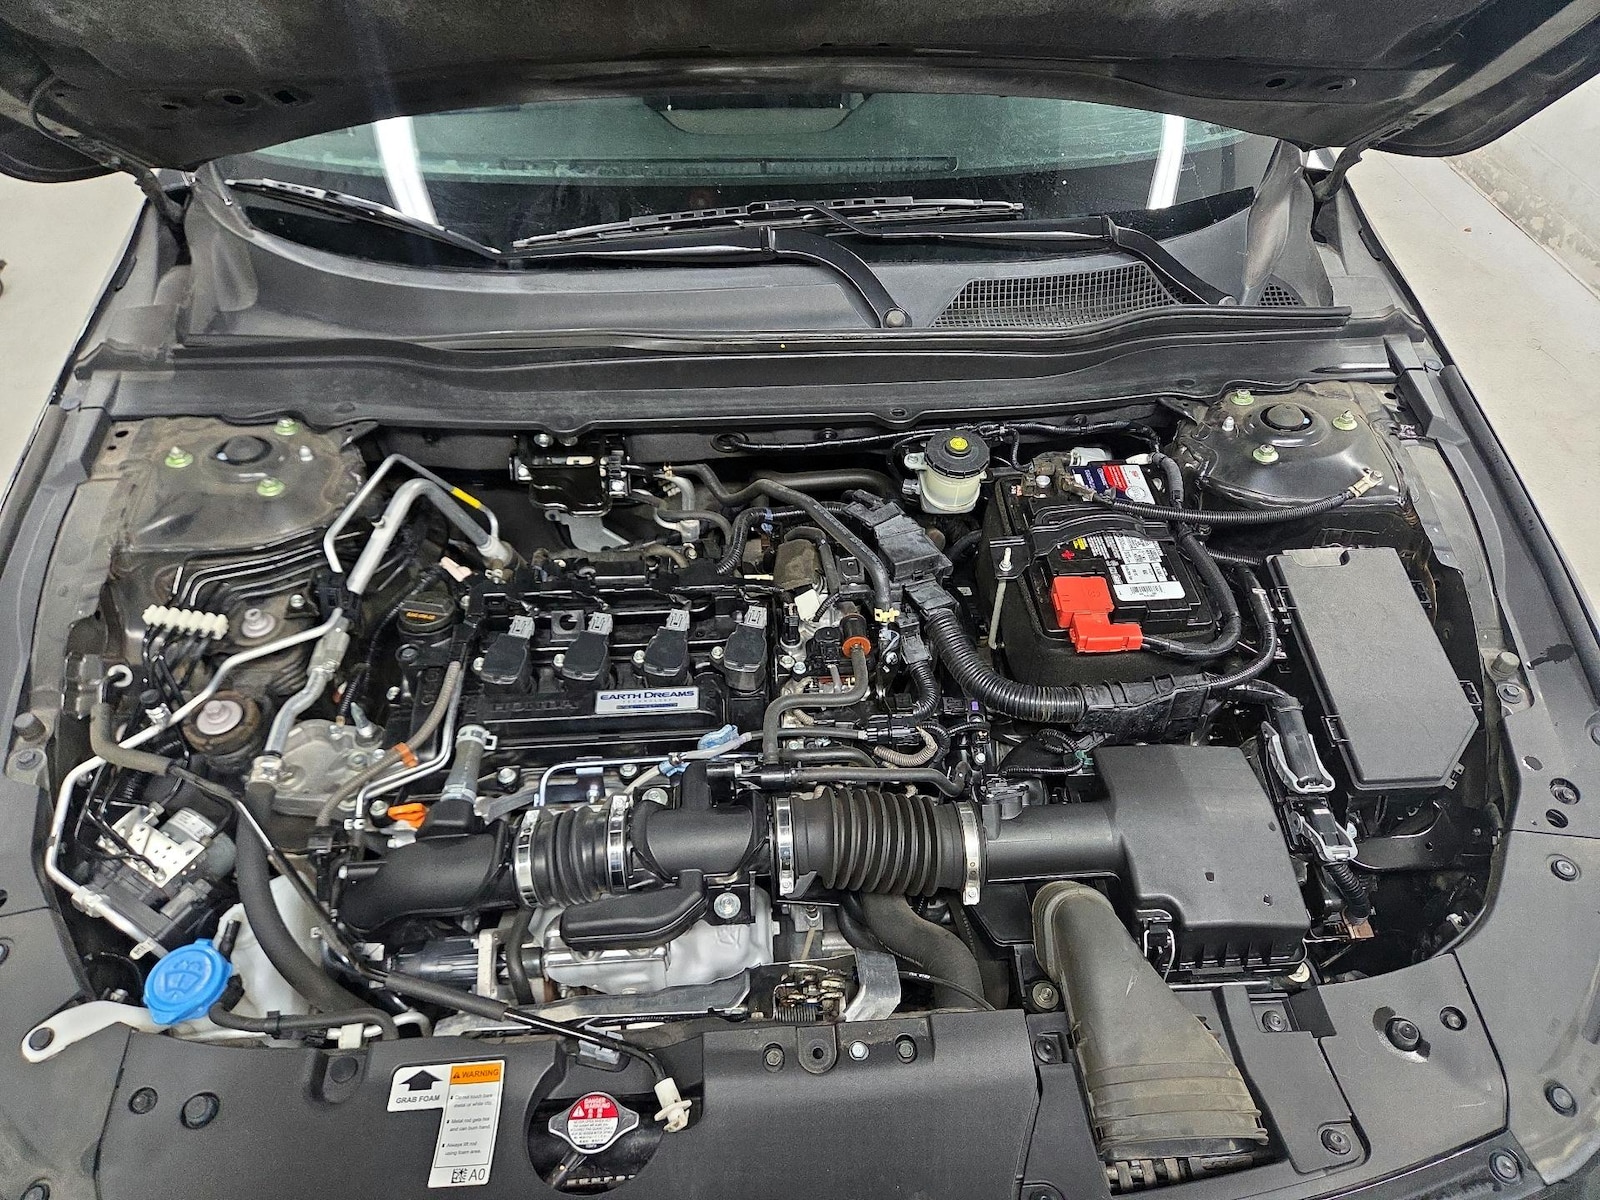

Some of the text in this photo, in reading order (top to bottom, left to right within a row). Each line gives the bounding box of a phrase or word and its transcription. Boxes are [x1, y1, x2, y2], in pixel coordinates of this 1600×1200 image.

[600, 690, 695, 700] EARTH DREAMS
[490, 700, 579, 712] HONDA
[461, 1069, 499, 1078] WARNING
[395, 1094, 440, 1104] GRAB FOAM
[468, 1168, 486, 1181] A0
